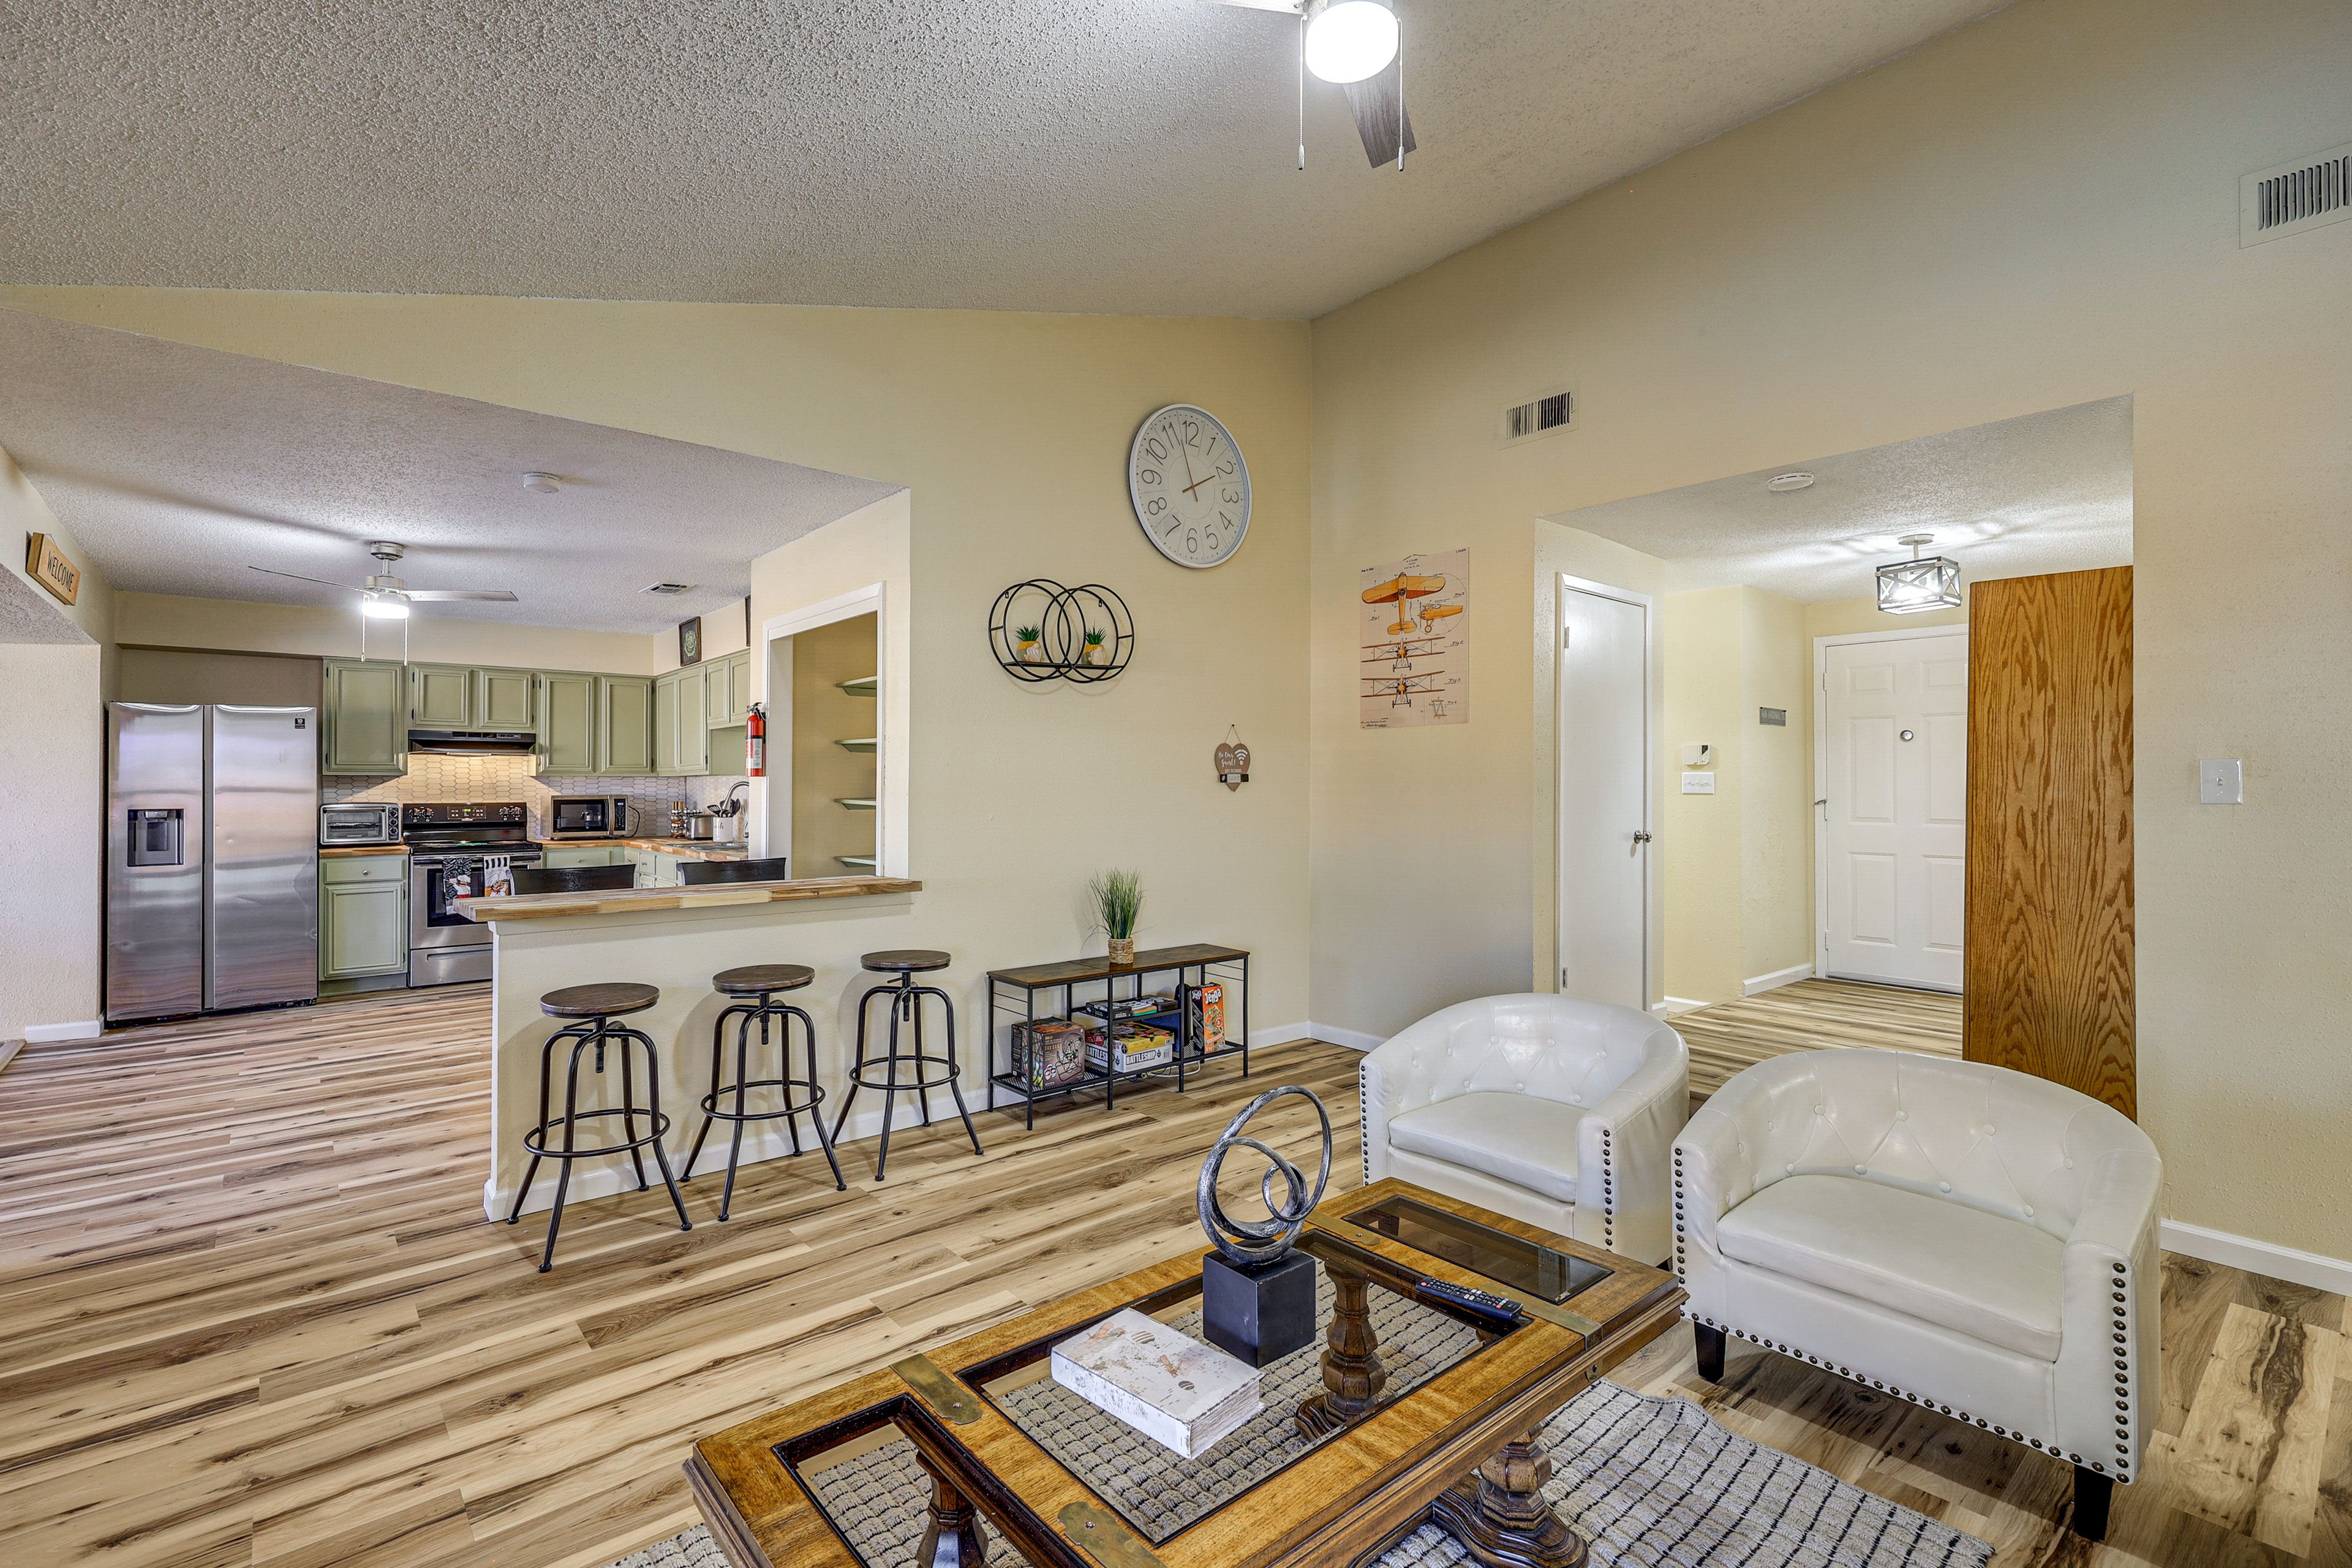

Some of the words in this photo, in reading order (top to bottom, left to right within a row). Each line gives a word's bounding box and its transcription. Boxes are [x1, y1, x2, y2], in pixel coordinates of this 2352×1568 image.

[1162, 421, 1180, 449] 11
[1182, 420, 1199, 448] 12
[1145, 438, 1167, 466] 10
[1207, 437, 1216, 456] 1
[1141, 469, 1162, 485] 9
[1215, 461, 1234, 480] 2
[1221, 488, 1239, 504] 3
[1148, 497, 1167, 516] 8
[1166, 514, 1182, 537] 7
[1219, 510, 1234, 530] 4
[1186, 528, 1197, 553] 6
[1205, 524, 1218, 549] 5
[47, 550, 74, 592] WELCOME
[1192, 990, 1202, 1000] Jenga
[1205, 988, 1222, 1005] Jenga
[1086, 1046, 1108, 1061] BATTLES
[1126, 1050, 1156, 1065] BATTLESHIP
